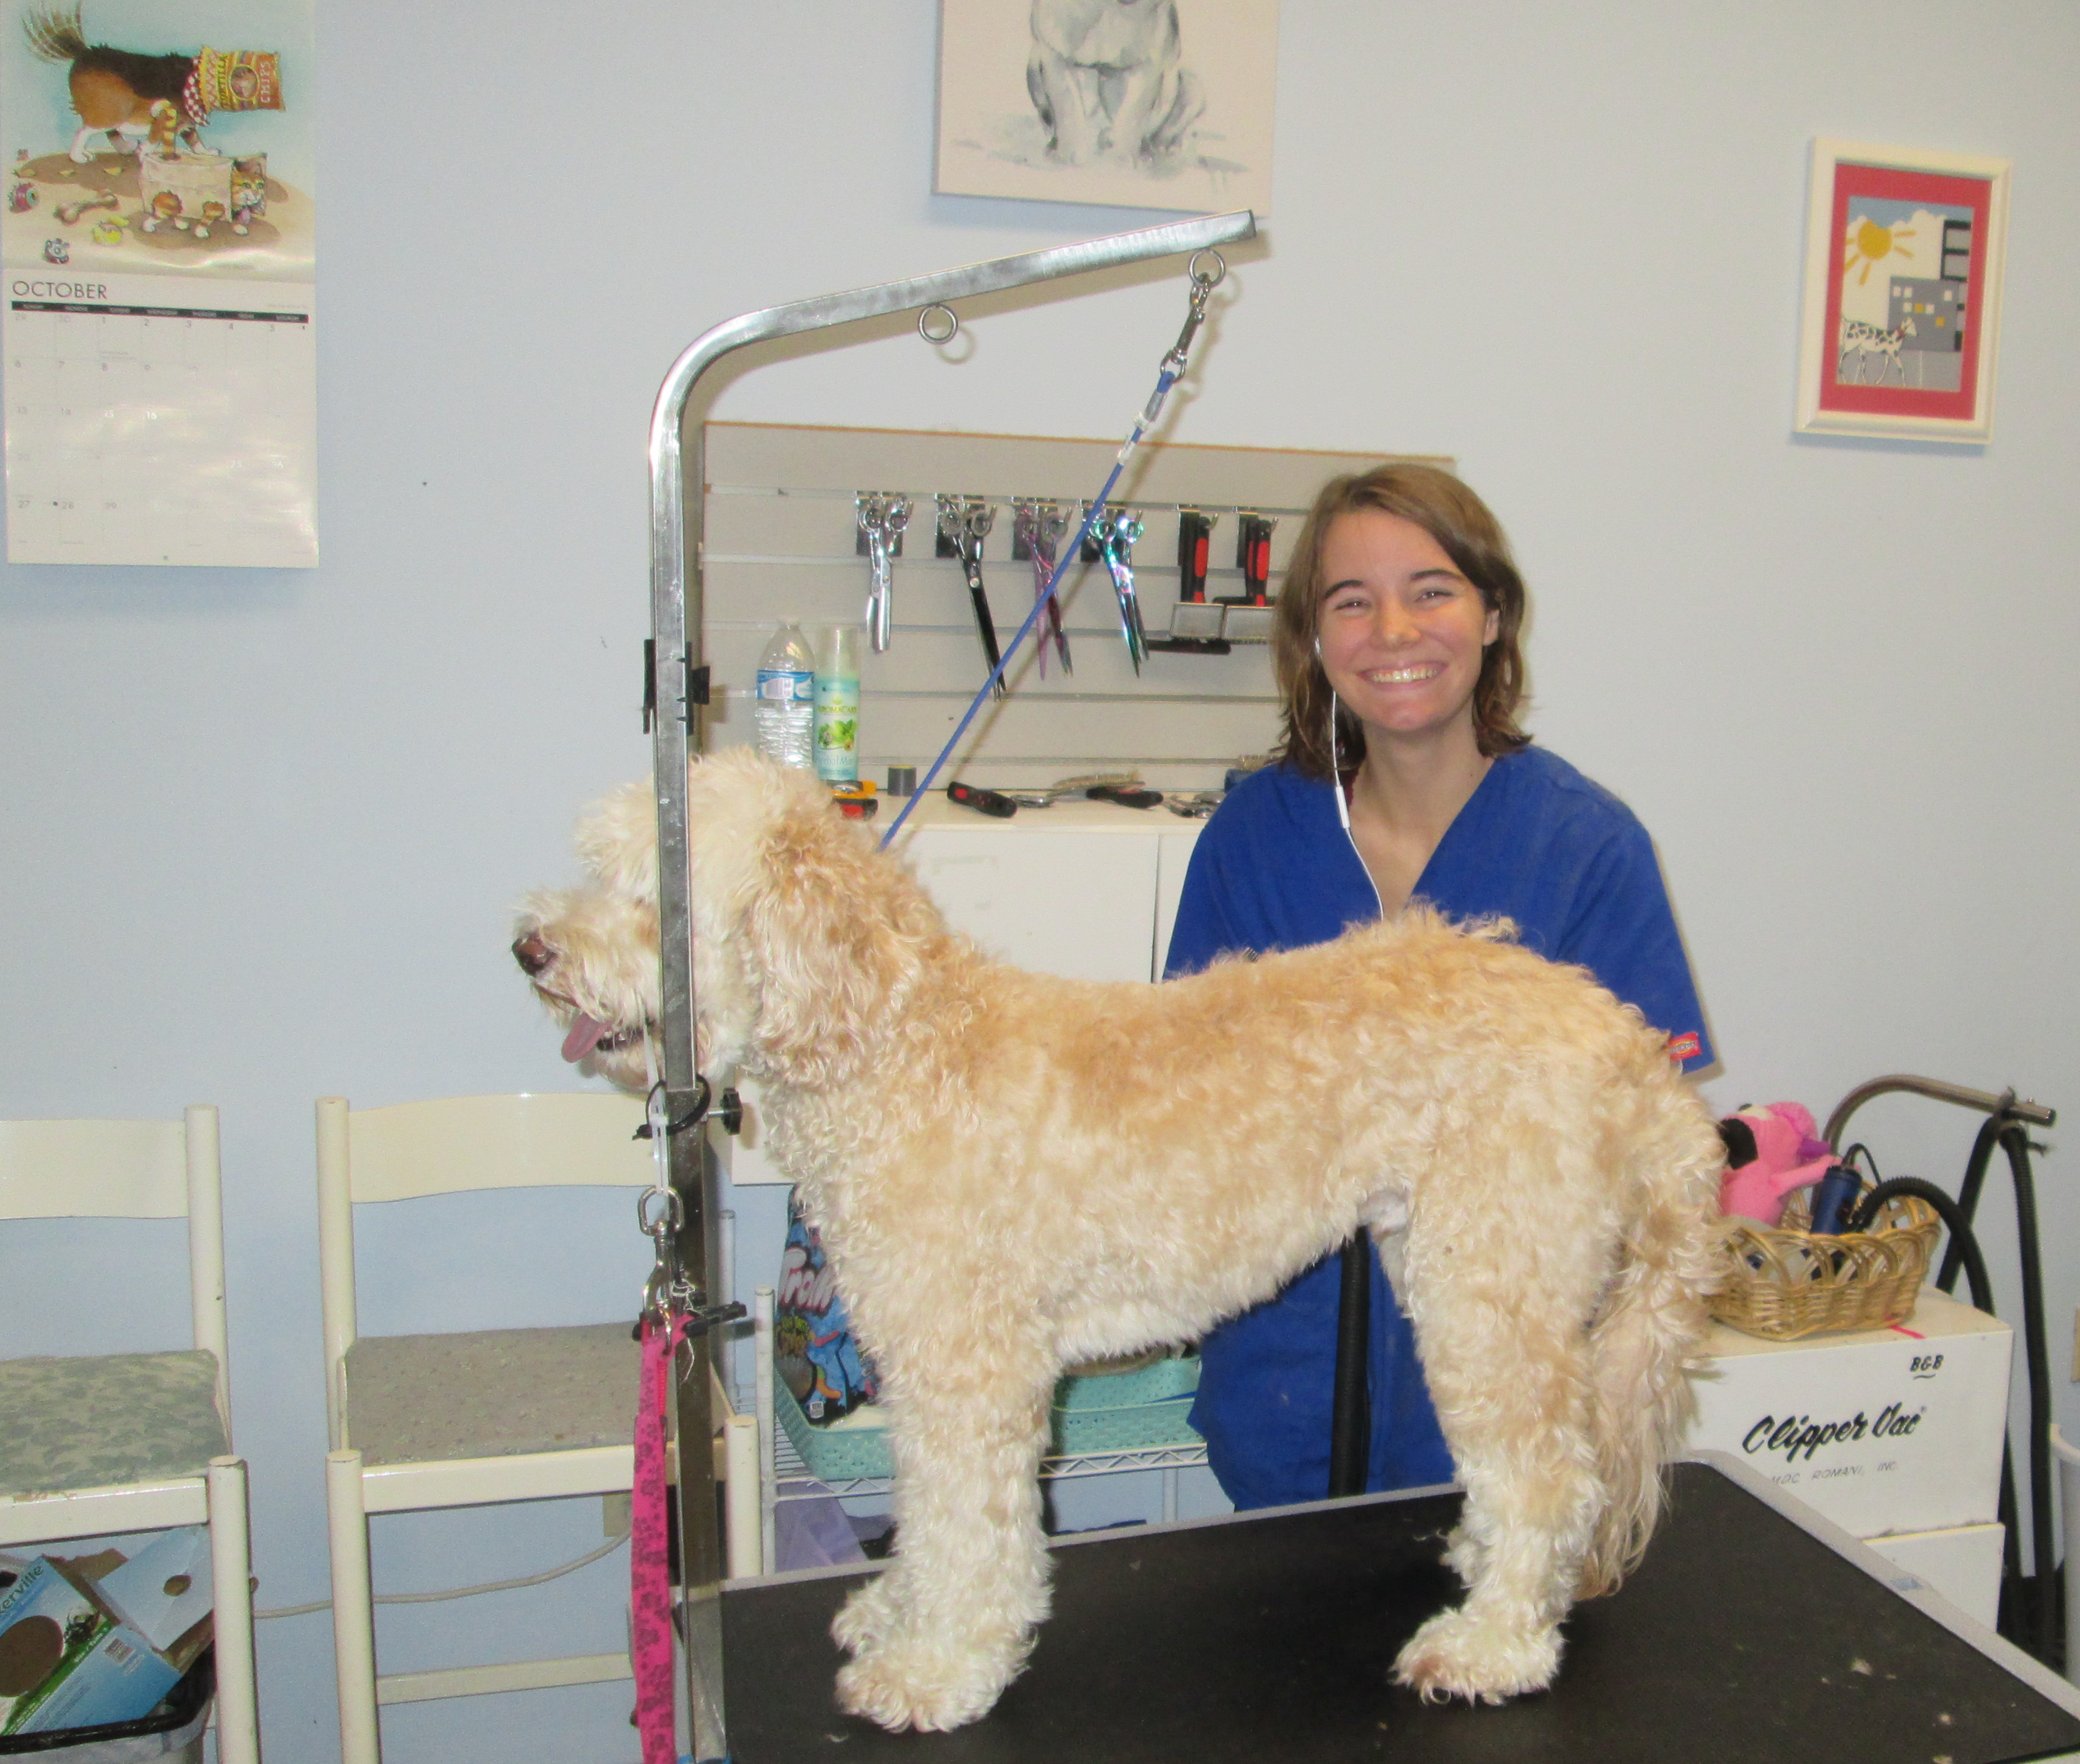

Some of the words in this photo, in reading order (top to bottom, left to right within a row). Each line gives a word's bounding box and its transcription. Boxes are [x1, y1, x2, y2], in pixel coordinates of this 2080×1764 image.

[260, 61, 271, 103] CHIPS
[12, 280, 107, 299] OCTOBER
[147, 411, 157, 419] 16
[1910, 1354, 1944, 1372] B&B
[1742, 1411, 1869, 1463] Clipper
[1871, 1402, 1921, 1438] Vac
